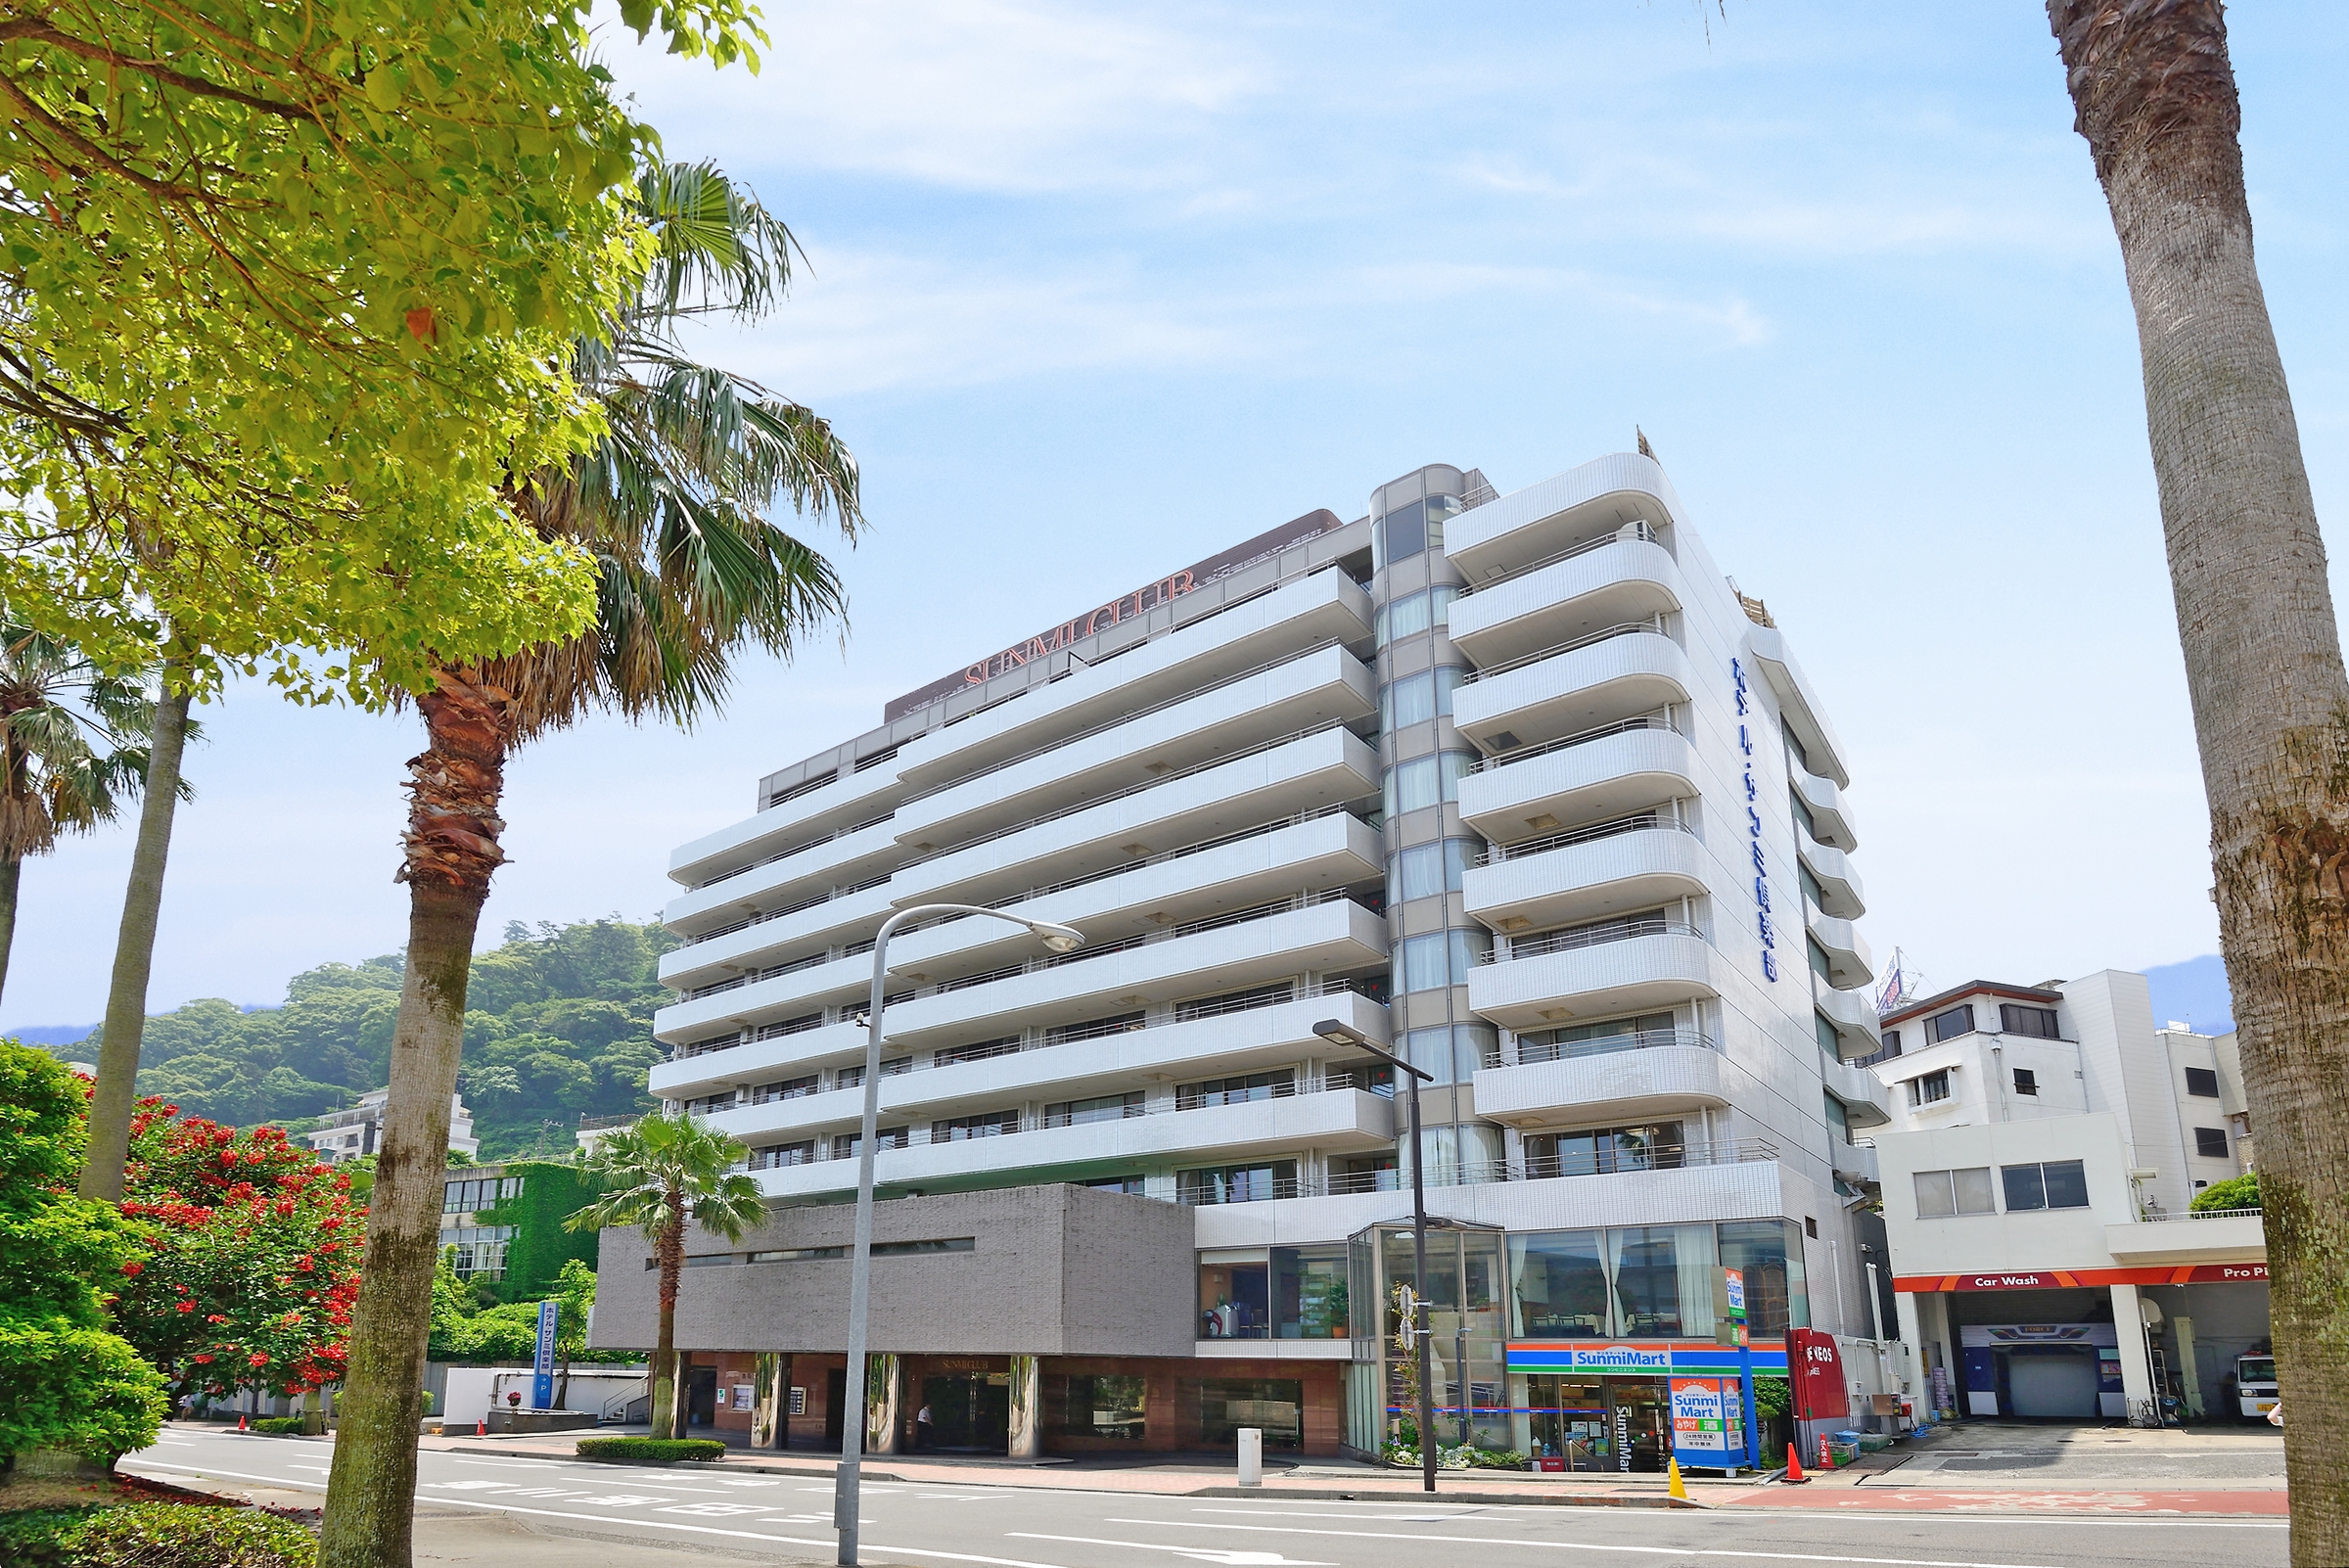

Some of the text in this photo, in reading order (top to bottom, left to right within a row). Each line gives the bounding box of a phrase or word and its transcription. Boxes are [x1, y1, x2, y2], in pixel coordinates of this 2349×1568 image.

[2223, 1267, 2270, 1278] Pro Pi
[1974, 1275, 2039, 1287] Car Wash
[1727, 1280, 1743, 1295] Sunmi
[1729, 1294, 1743, 1307] Mart
[1577, 1352, 1666, 1365] SunmiMart
[1675, 1395, 1718, 1407] Sunmi
[1681, 1407, 1714, 1417] Mart
[1676, 1419, 1697, 1430] みやげ
[1616, 1406, 1633, 1473] SunmiMar
